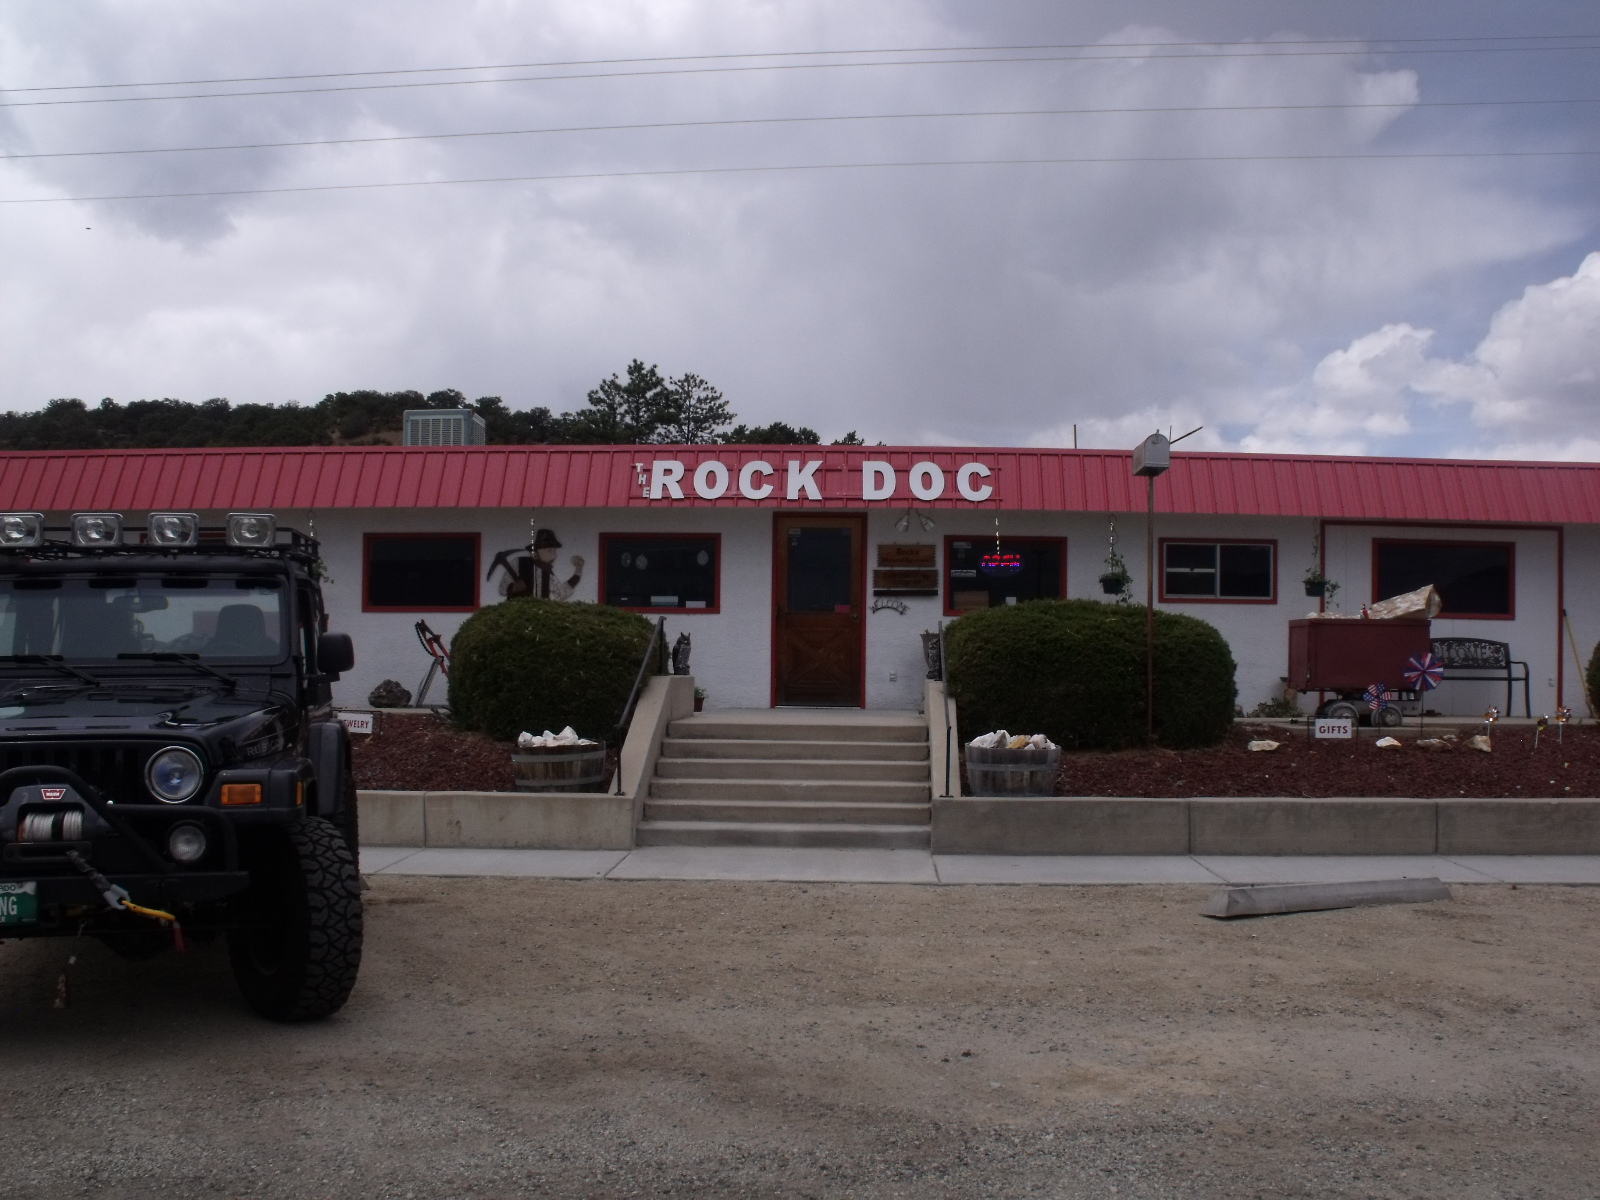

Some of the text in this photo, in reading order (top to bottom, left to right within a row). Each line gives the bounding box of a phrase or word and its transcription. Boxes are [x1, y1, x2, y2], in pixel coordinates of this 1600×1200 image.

[635, 462, 651, 498] THE
[649, 460, 993, 502] ROCK DOC
[868, 597, 910, 615] WELCOME
[344, 719, 370, 729] WELRY
[1319, 725, 1348, 734] GIFTS
